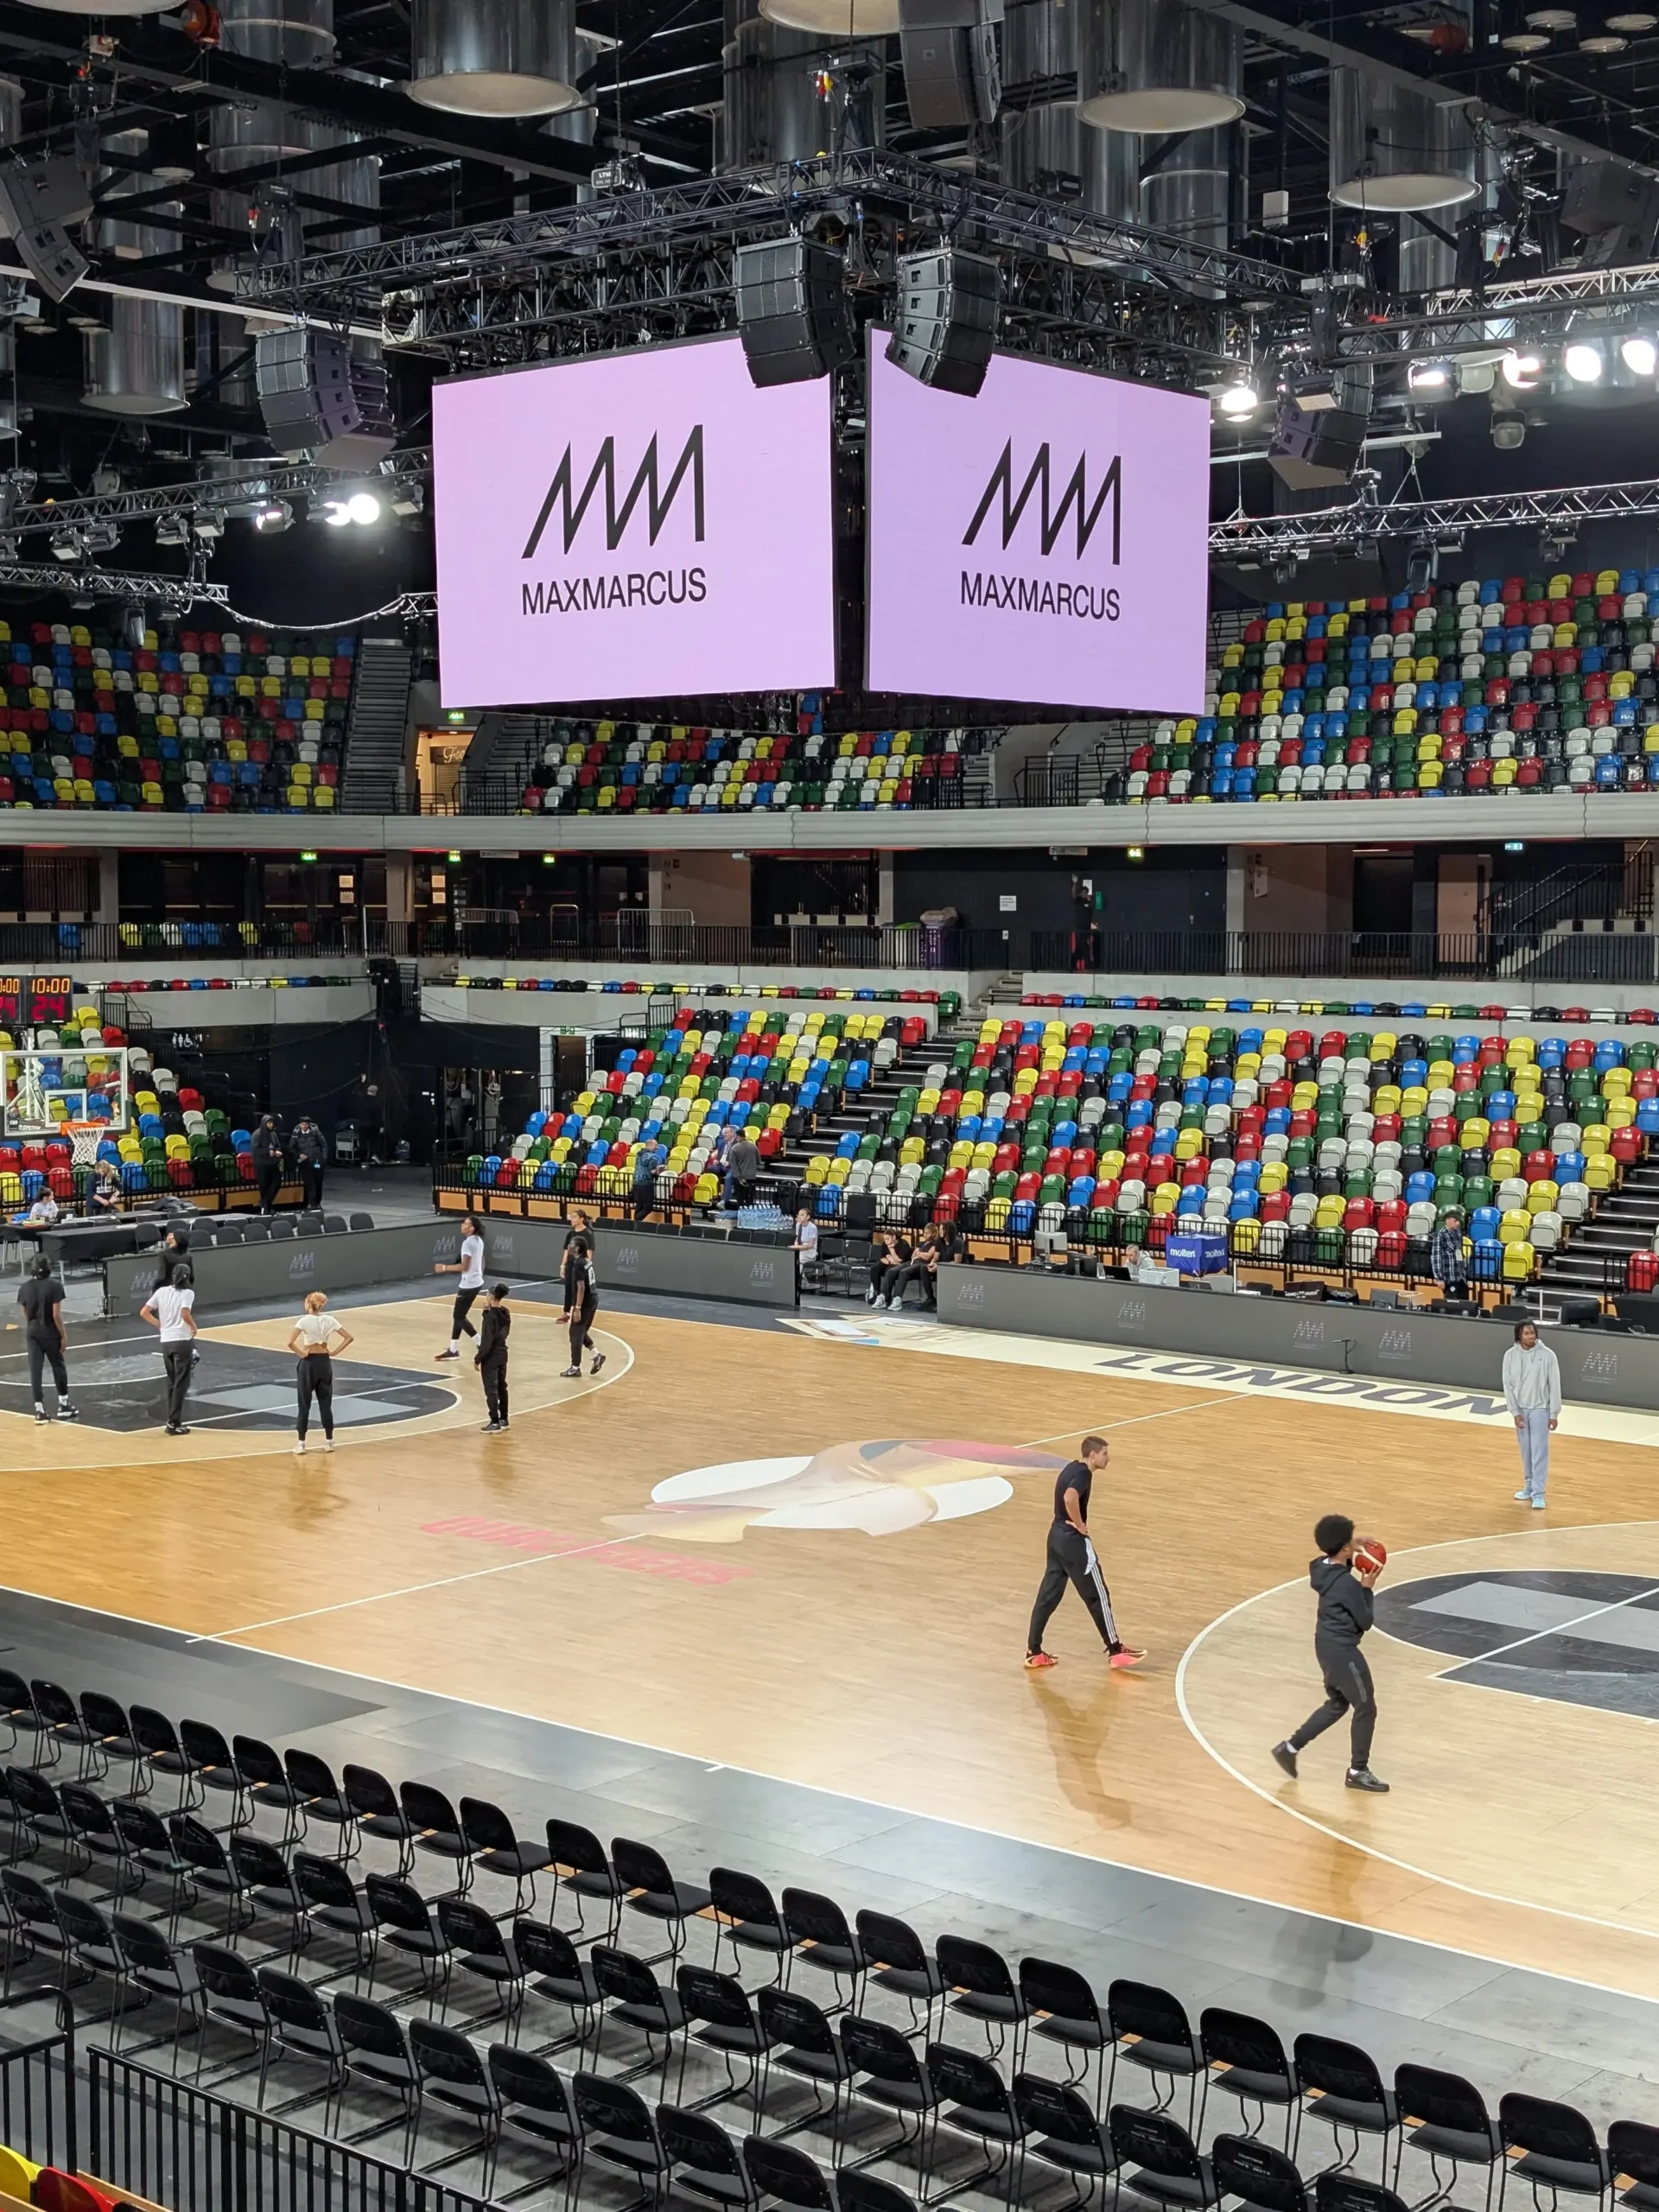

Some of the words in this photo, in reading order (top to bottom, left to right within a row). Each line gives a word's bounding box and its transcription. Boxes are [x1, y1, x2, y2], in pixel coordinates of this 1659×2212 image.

[522, 567, 707, 615] MAXMARCUS
[961, 570, 1121, 621] MAXMARCUS
[31, 978, 70, 994] 10:00
[32, 995, 65, 1020] 24
[1169, 1248, 1196, 1258] molten
[1094, 1353, 1509, 1416] LONDON
